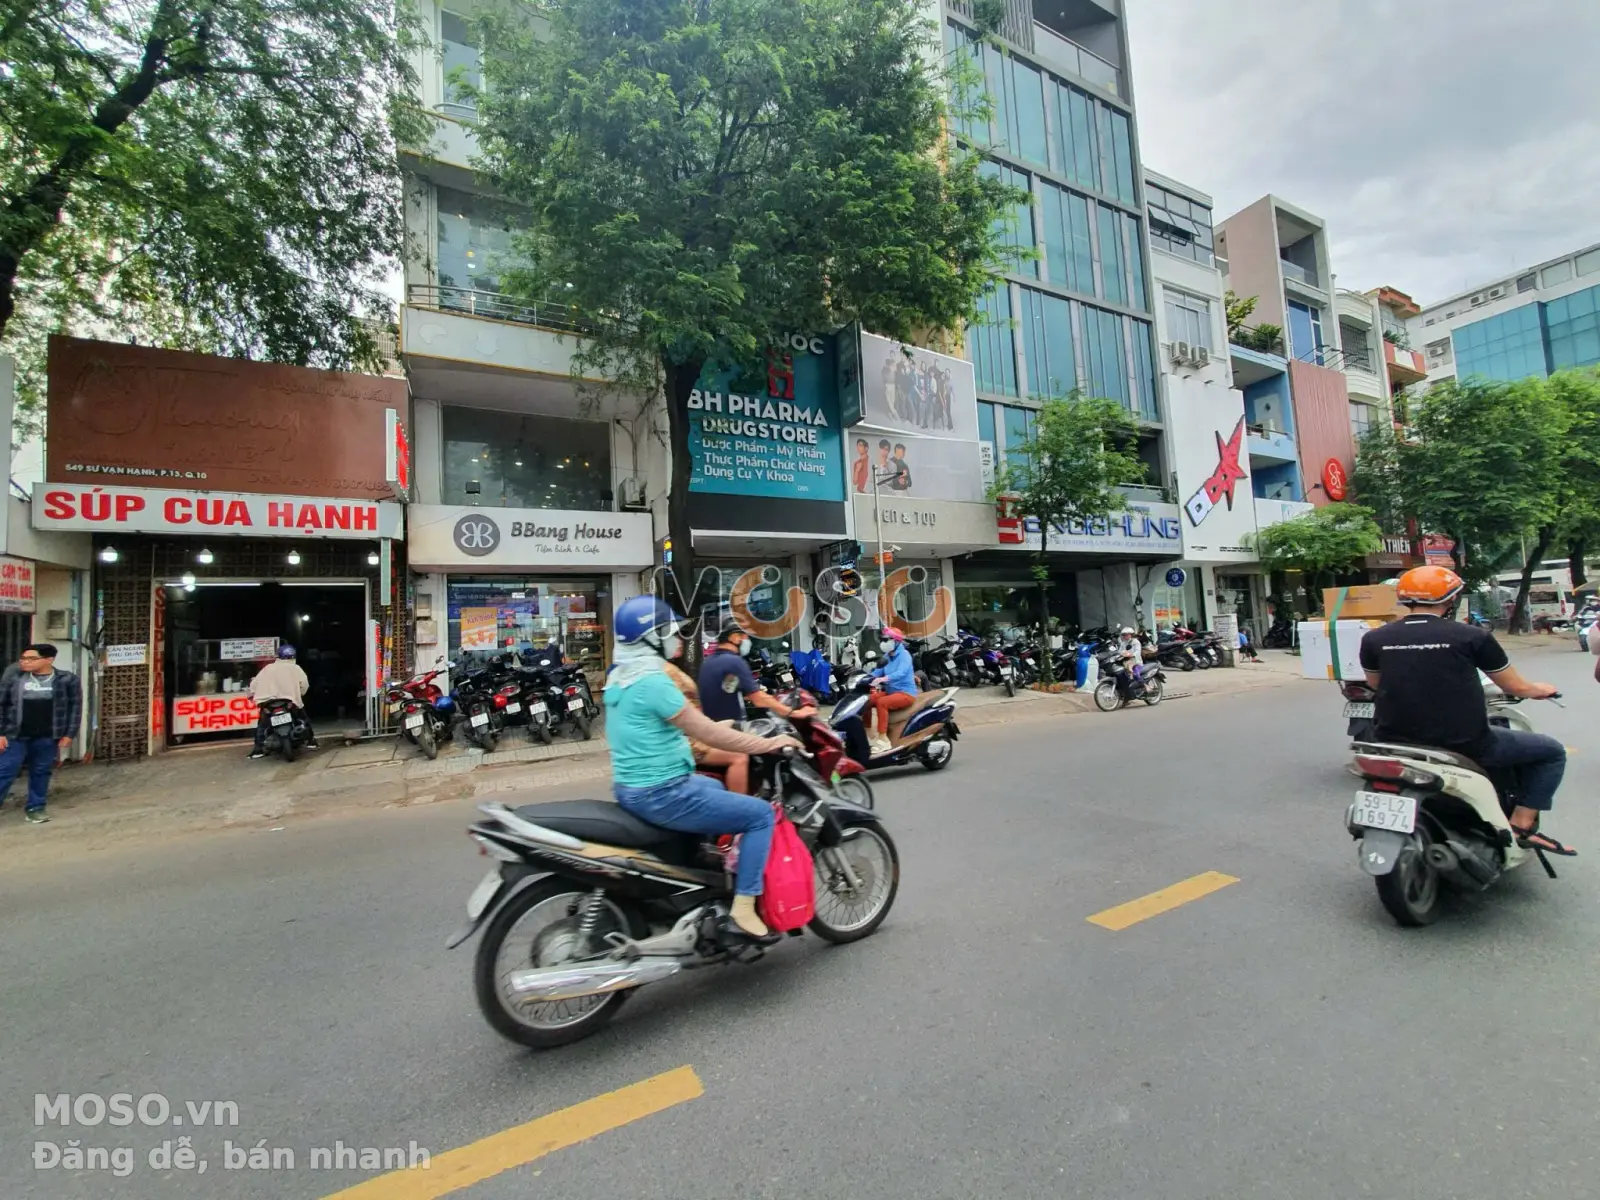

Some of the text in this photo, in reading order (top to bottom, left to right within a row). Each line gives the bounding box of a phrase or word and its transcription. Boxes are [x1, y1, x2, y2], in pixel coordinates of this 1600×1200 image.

[687, 388, 828, 427] BH PHARMA
[702, 416, 818, 444] DRUGSTORE
[703, 464, 735, 480] Dụng
[737, 468, 752, 480] Cụ
[766, 471, 795, 482] Khoa
[44, 487, 377, 534] SÚP CUA HẠNH
[511, 521, 622, 541] BBang House
[177, 696, 226, 716] SÚP
[1364, 795, 1405, 813] 59-L2
